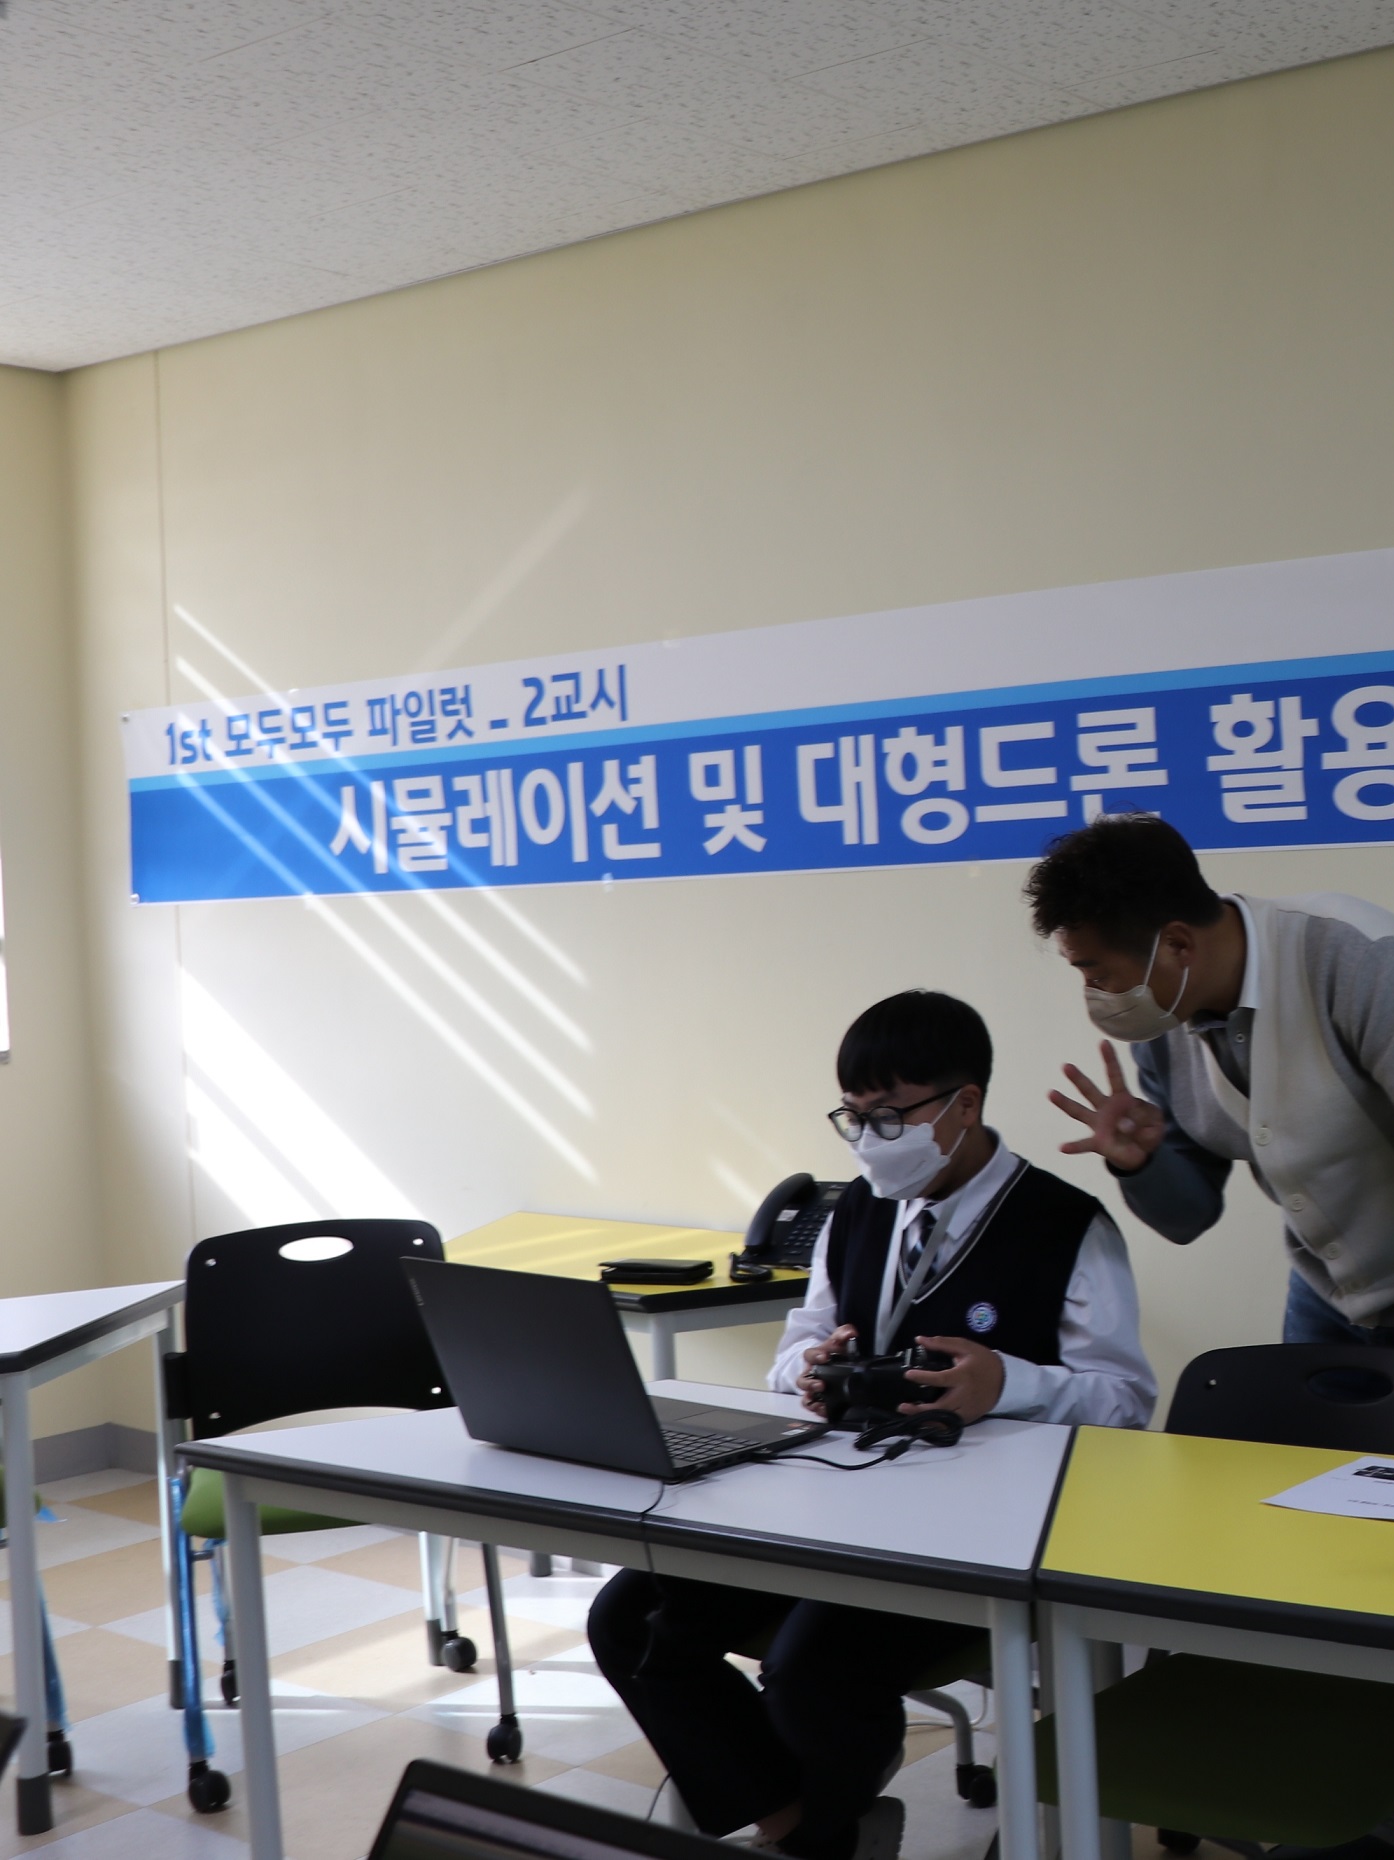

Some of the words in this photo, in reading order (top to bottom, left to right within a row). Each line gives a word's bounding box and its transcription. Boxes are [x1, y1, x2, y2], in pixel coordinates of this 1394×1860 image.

[165, 721, 213, 766] 1st
[224, 700, 352, 760] 모두모두
[366, 684, 476, 747] 파일럿
[521, 664, 629, 729] 2교시
[329, 755, 663, 875] 시뮬레이션
[689, 744, 768, 857] 및
[797, 706, 1169, 847] 대형드론
